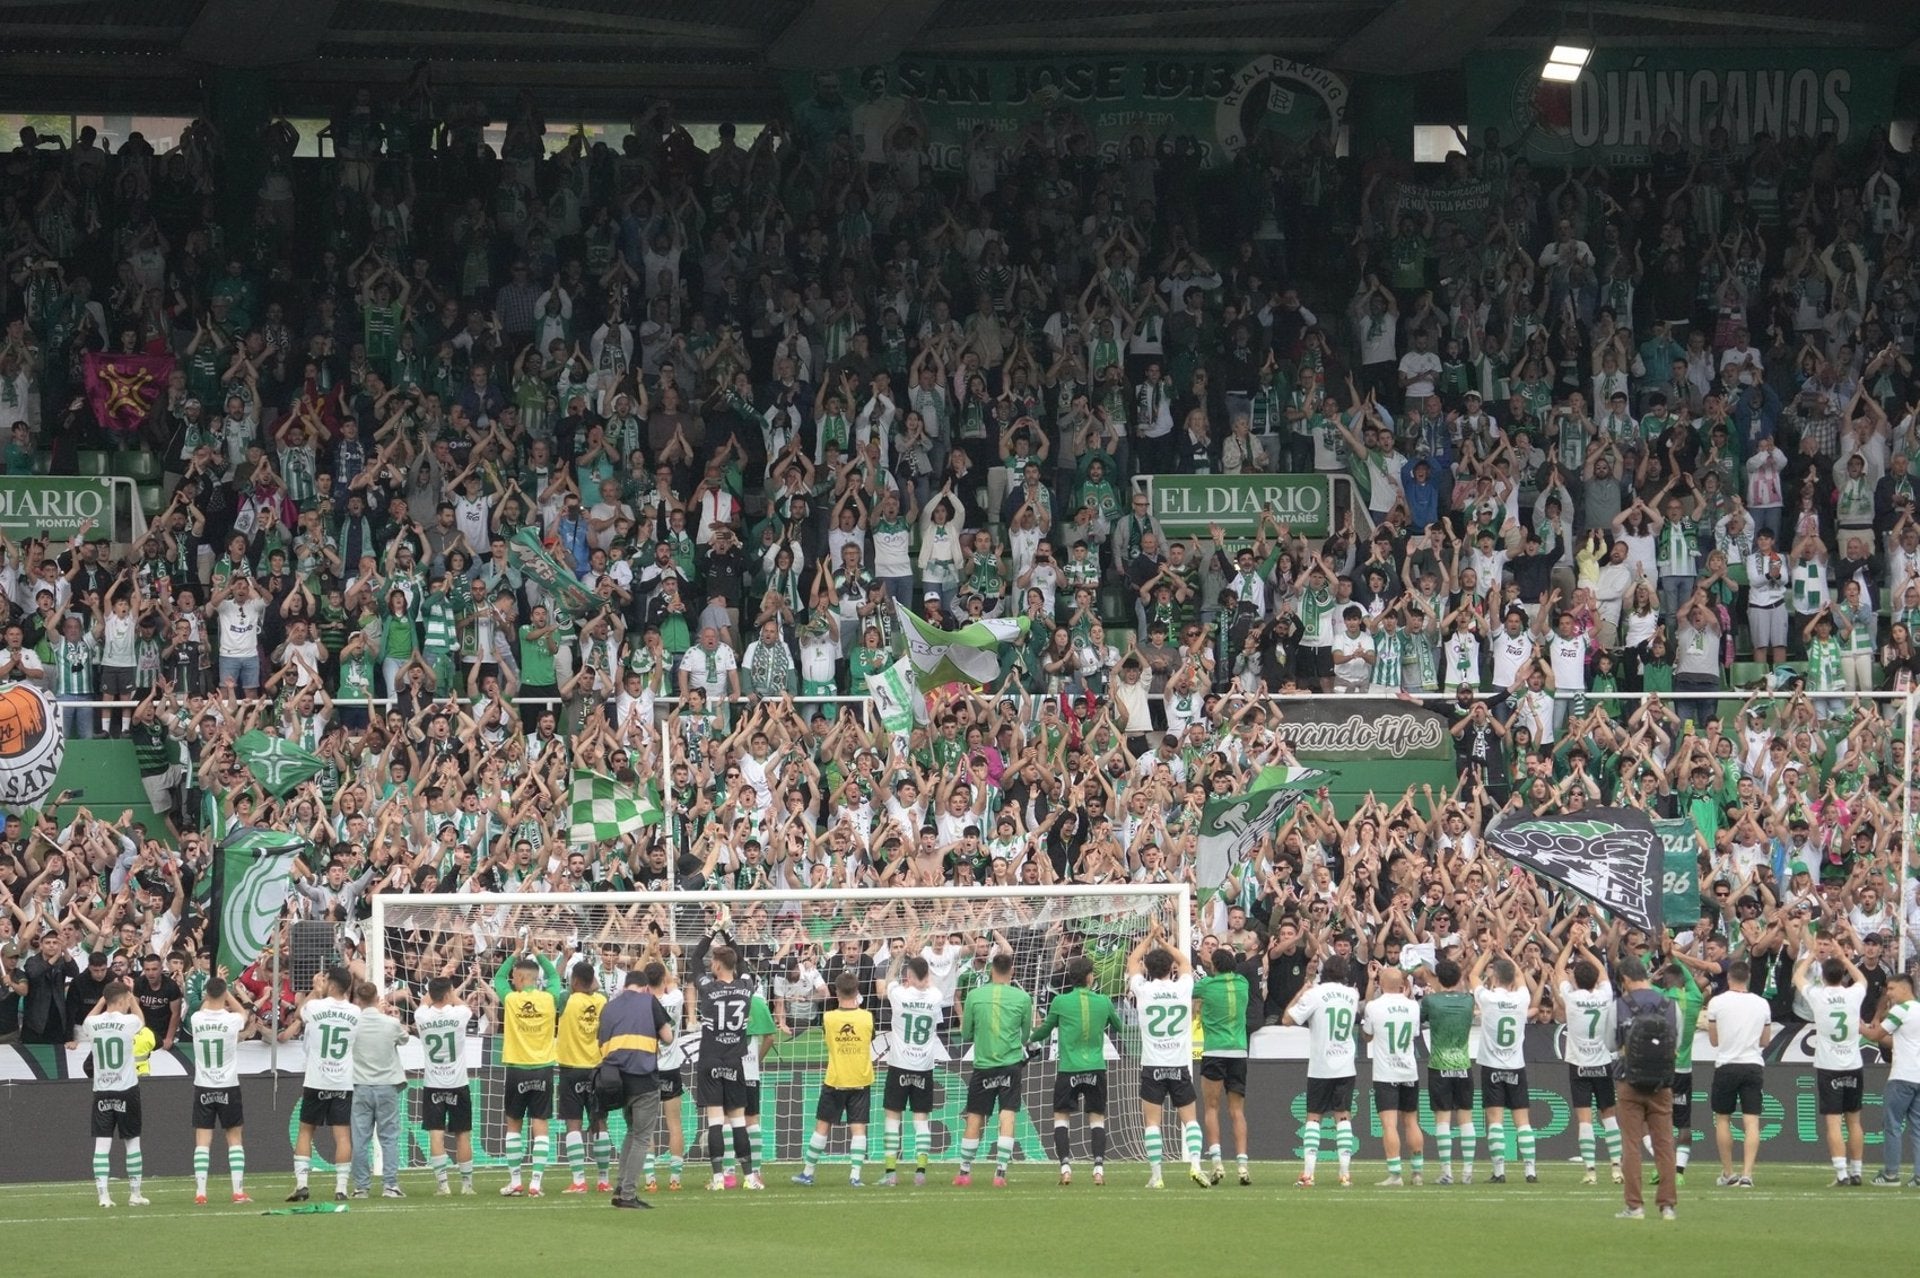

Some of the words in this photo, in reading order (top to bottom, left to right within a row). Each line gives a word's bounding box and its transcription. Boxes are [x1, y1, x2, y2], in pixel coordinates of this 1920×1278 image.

[897, 62, 992, 105] SAN
[1005, 61, 1130, 106] JOSE
[1141, 60, 1236, 102] 1913
[1224, 64, 1265, 108] REAL
[1271, 58, 1343, 102] RACING
[1570, 55, 1852, 148] OJÁNCANOS
[0, 490, 103, 518] IARIO
[1159, 487, 1201, 514] EL
[1205, 486, 1321, 514] DIARIO
[1268, 512, 1318, 523] ONTAÑÉS
[1506, 645, 1523, 656] Teka
[1560, 648, 1577, 658] Teka
[1375, 714, 1442, 758] tifos
[93, 1022, 125, 1031] VICENTE
[194, 1023, 229, 1033] ANDRÉS
[713, 1000, 747, 1031] 13
[901, 1013, 933, 1045] 18
[1145, 1005, 1188, 1037] 22
[1325, 1007, 1352, 1041] 19
[1497, 1016, 1516, 1046] 6
[1584, 1009, 1600, 1039] 7
[1829, 1011, 1848, 1042] 3
[94, 1036, 124, 1069] 10
[199, 1038, 224, 1068] 11
[318, 1024, 351, 1059] 15
[425, 1031, 456, 1063] 21
[1384, 1021, 1412, 1054] 14
